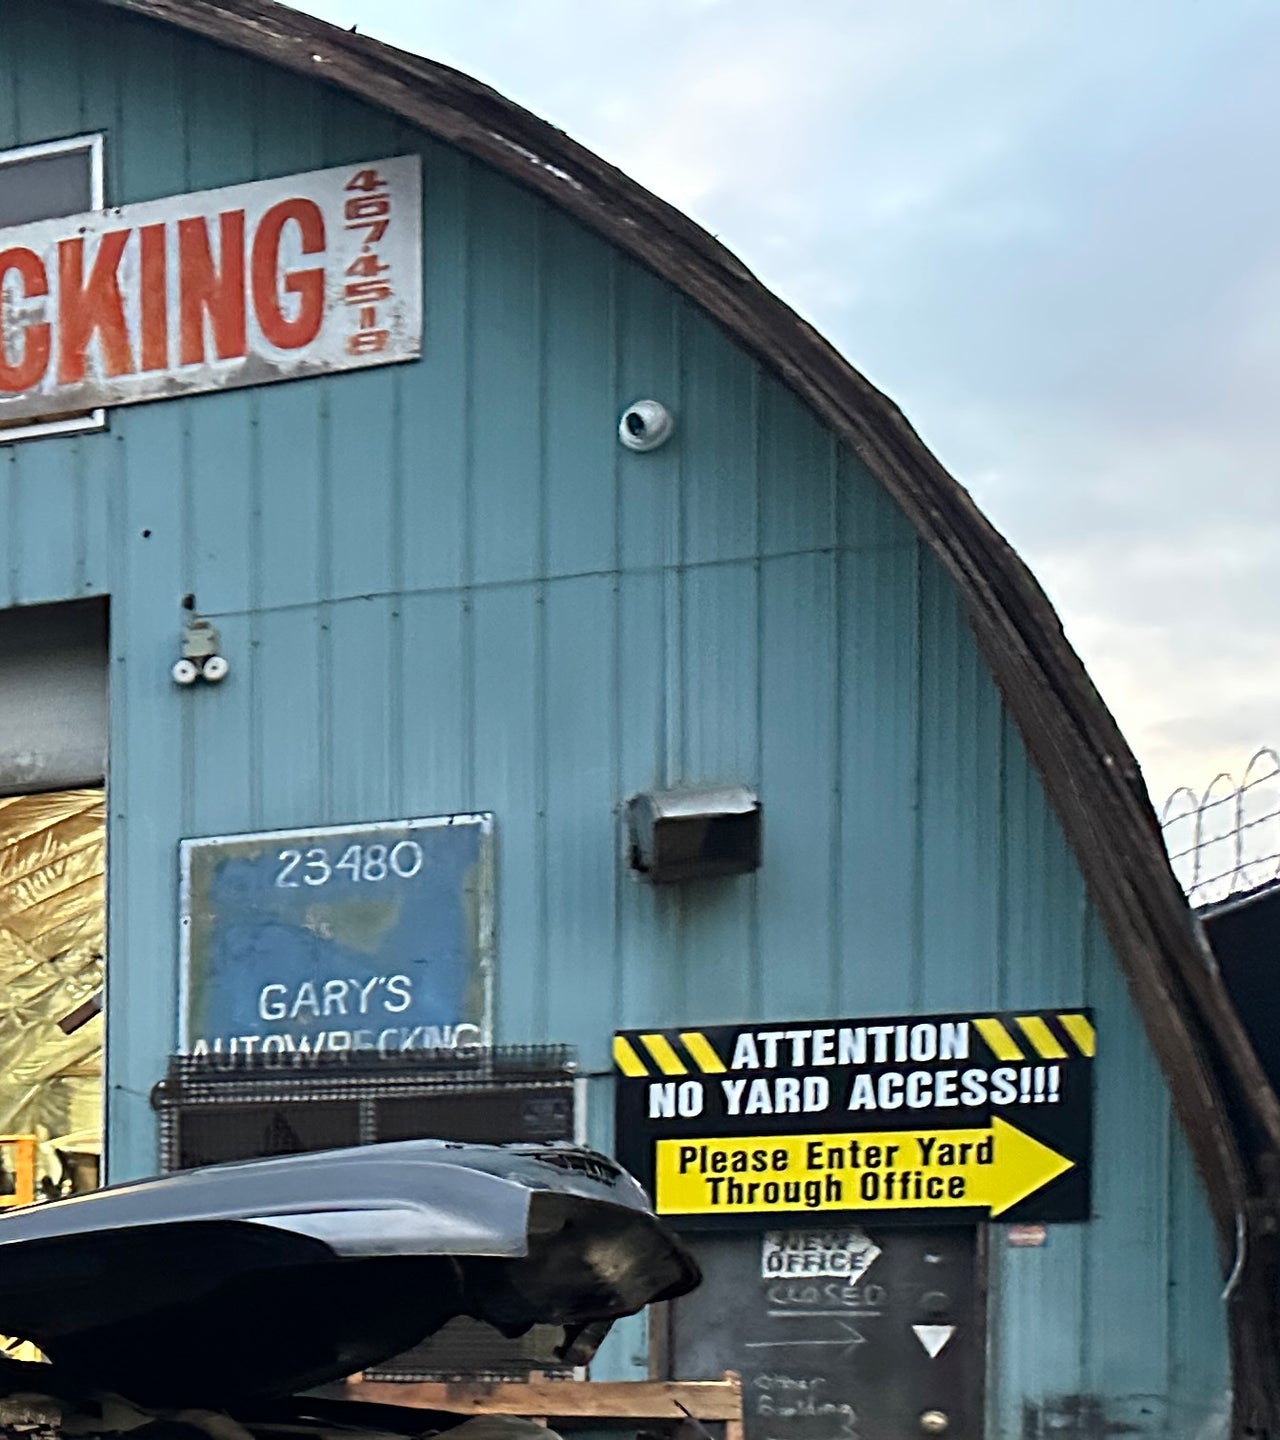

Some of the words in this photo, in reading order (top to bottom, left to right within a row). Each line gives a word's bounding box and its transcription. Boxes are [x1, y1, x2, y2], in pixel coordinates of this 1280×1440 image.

[276, 840, 423, 888] 23480
[258, 974, 413, 1021] GARY'S
[731, 1022, 970, 1070] ATTENTION
[648, 1081, 703, 1118] NO
[721, 1075, 830, 1115] YARD
[848, 1066, 1061, 1111] ACCESS!!!
[679, 1145, 789, 1174] Please
[806, 1141, 899, 1170] Enter
[916, 1136, 994, 1166] Yard
[706, 1177, 841, 1208] Through
[861, 1173, 966, 1201] Office
[767, 1250, 864, 1272] OFFICE
